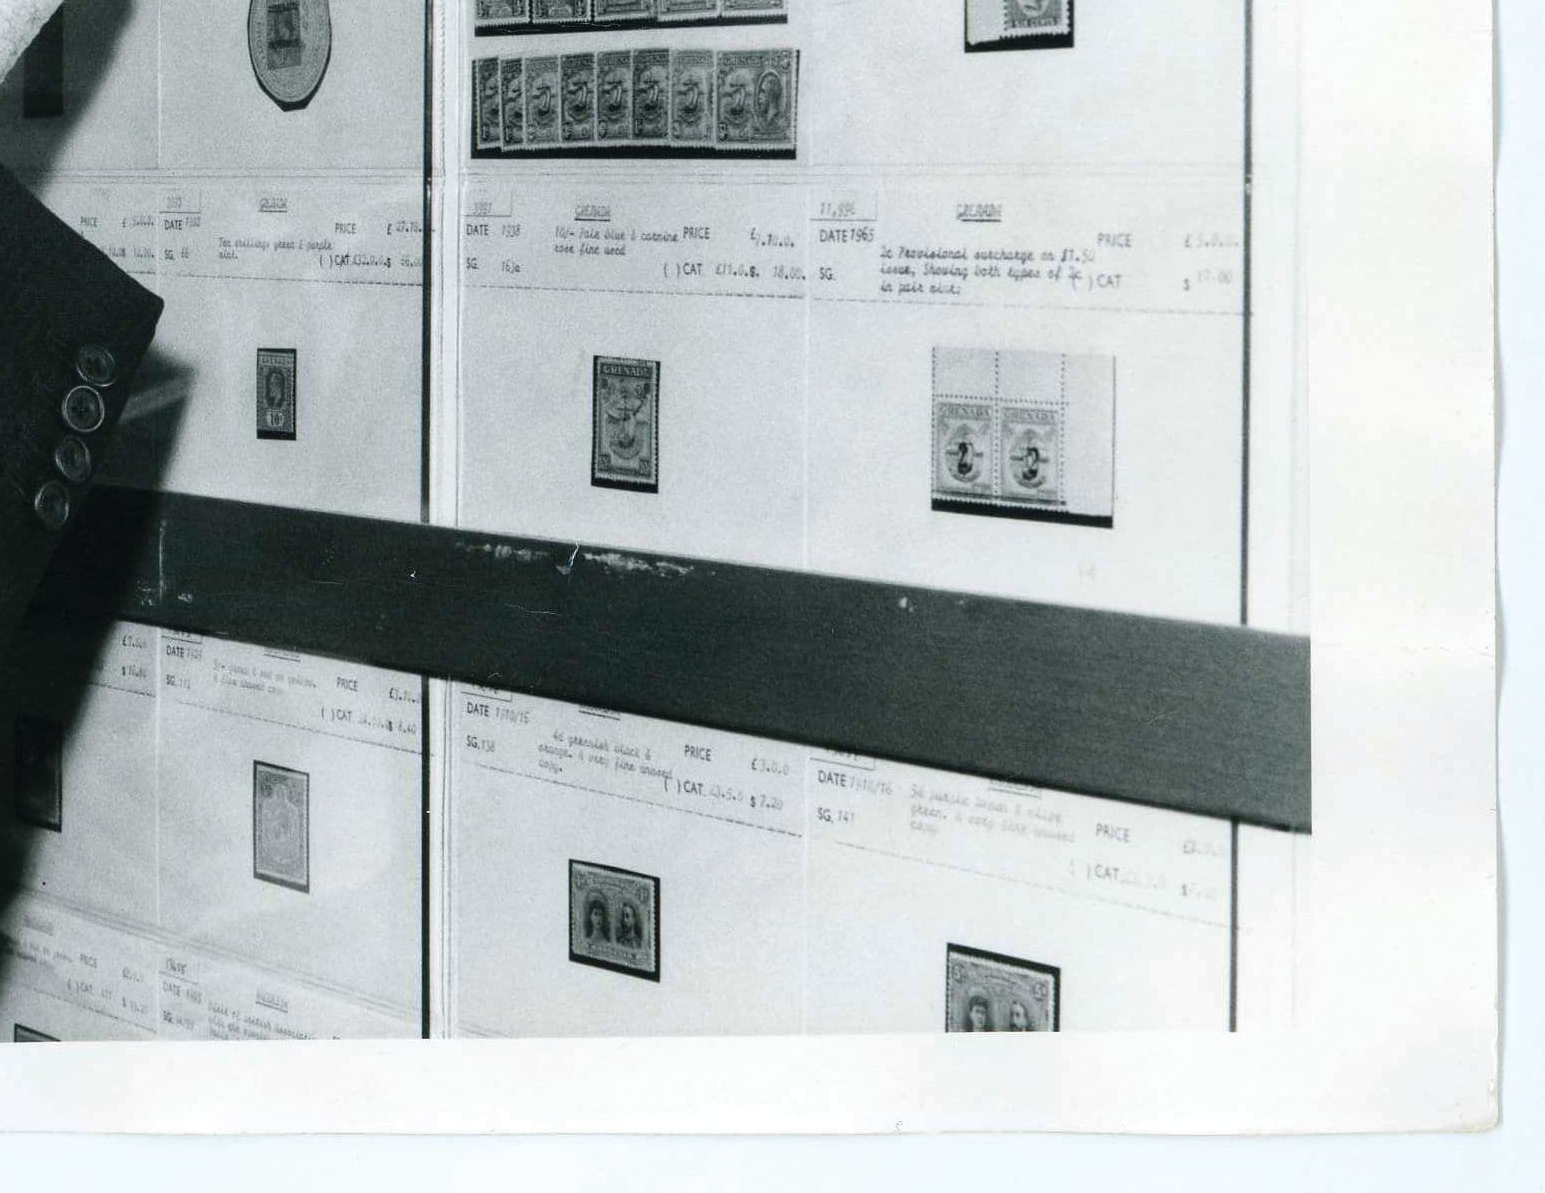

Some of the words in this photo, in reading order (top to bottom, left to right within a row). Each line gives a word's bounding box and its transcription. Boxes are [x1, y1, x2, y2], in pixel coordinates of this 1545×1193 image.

[164, 219, 183, 231] DATE
[335, 222, 357, 234] PRICE
[466, 224, 489, 236] DATE
[604, 228, 626, 240] blue
[683, 226, 710, 240] PRICE
[819, 228, 848, 243] DATE
[850, 227, 875, 243] 1965
[1097, 233, 1132, 248] PRICE
[219, 237, 231, 248] Ten
[579, 243, 600, 256] fine
[604, 244, 626, 256] used
[334, 253, 350, 266] CAT
[898, 246, 967, 260] Provisional
[974, 249, 1034, 265] surcharge
[683, 262, 703, 276] CAT
[880, 264, 916, 277] issue,
[923, 265, 968, 281] Showing
[974, 267, 1001, 277] both
[1008, 267, 1041, 282] types
[1048, 265, 1061, 281] of
[880, 281, 893, 293] in
[898, 282, 924, 296] pair
[1097, 274, 1122, 288] CAT
[166, 645, 184, 659] DATE
[336, 677, 358, 693] PRICE
[336, 708, 353, 721] CAT
[467, 702, 490, 718] DATE
[568, 735, 609, 752] greenish
[614, 742, 641, 759] black
[684, 743, 712, 762] PRICE
[588, 753, 609, 768] very
[614, 757, 636, 771] fine
[639, 764, 673, 779] unused
[817, 769, 847, 788] DATE
[683, 779, 704, 796] CAT
[1095, 822, 1130, 843] PRICE
[1094, 863, 1120, 881] CAT
